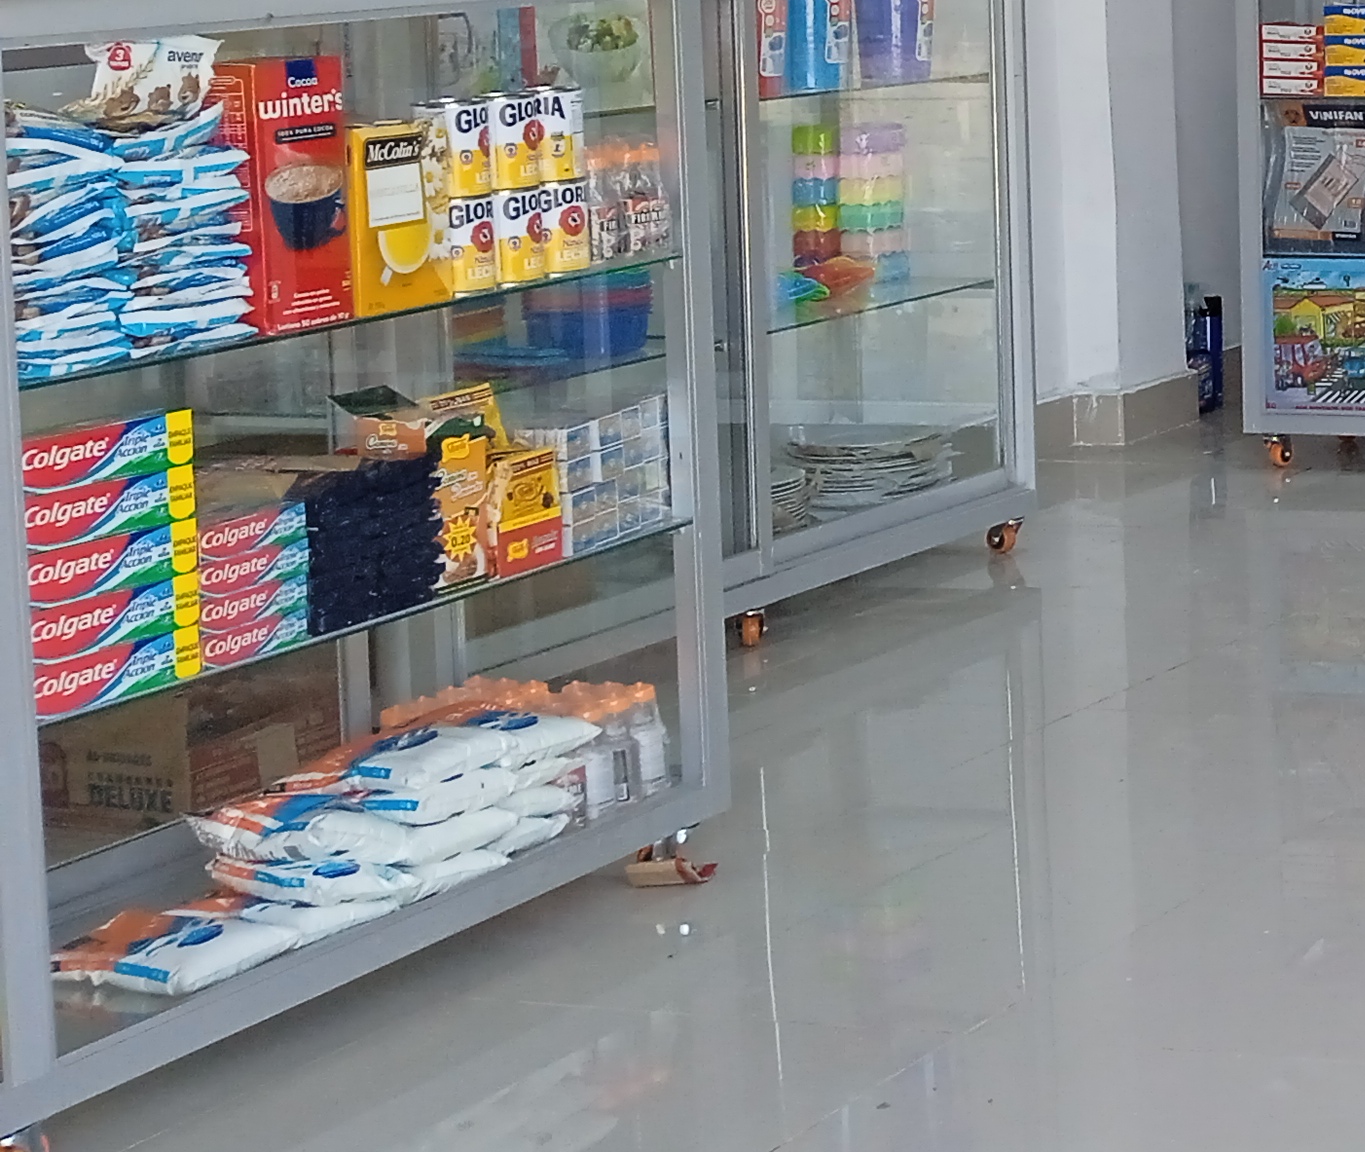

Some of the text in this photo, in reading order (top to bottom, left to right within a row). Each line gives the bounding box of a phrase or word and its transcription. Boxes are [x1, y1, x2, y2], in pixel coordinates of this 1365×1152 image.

[287, 76, 318, 88] Cocoa
[258, 89, 343, 120] winter's
[1309, 110, 1365, 121] VINIFAN
[455, 107, 489, 133] GLO
[367, 138, 420, 163] McColin's
[538, 186, 586, 213] GLOR
[449, 200, 494, 229] GLOR
[22, 439, 108, 470] Colgate
[24, 495, 109, 528] Colgate
[201, 521, 266, 549] Colgate
[451, 534, 470, 547] 0.20
[27, 551, 112, 586] Colgate
[200, 557, 269, 585] Colgate
[201, 593, 267, 622] Colgate
[30, 607, 114, 642] Colgate
[205, 627, 269, 657] Colgate
[33, 661, 115, 699] Colgate
